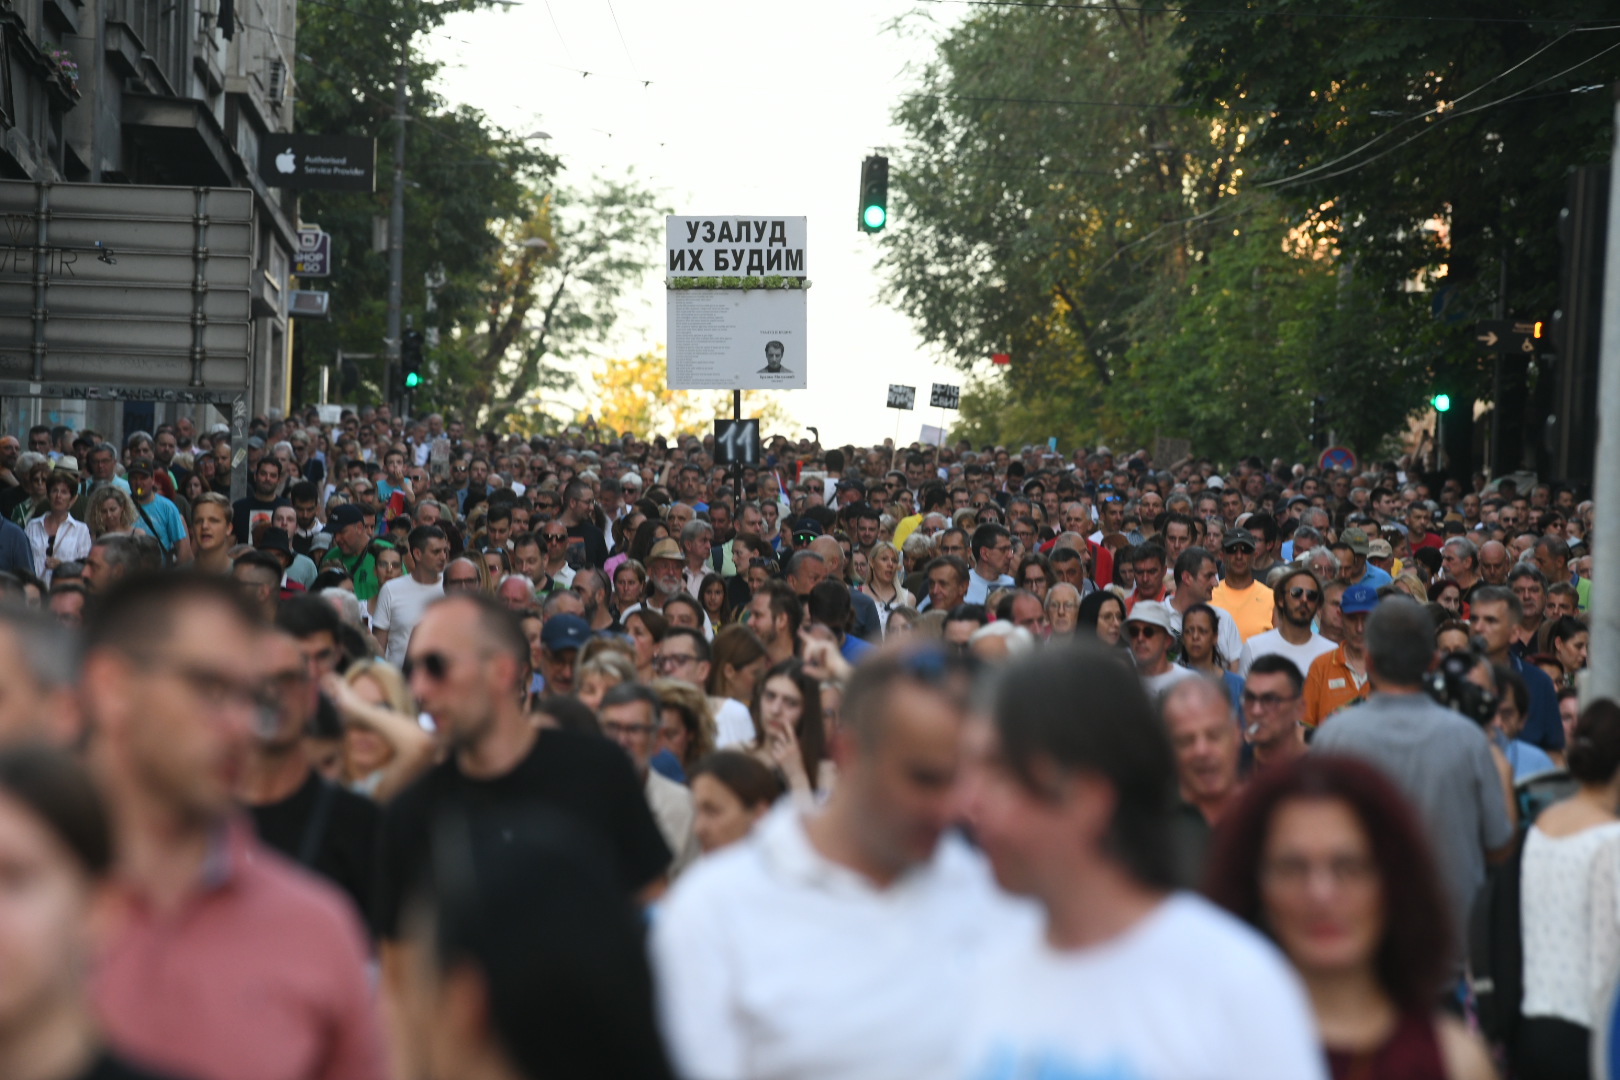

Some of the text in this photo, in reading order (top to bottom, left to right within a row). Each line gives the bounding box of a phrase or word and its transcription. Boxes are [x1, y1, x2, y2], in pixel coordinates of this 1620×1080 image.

[305, 155, 347, 165] Authorised
[305, 165, 365, 176] Service Provider
[686, 220, 787, 247] УЗАЛУД
[669, 249, 804, 275] ИХ БУДИМ
[717, 421, 755, 464] 11
